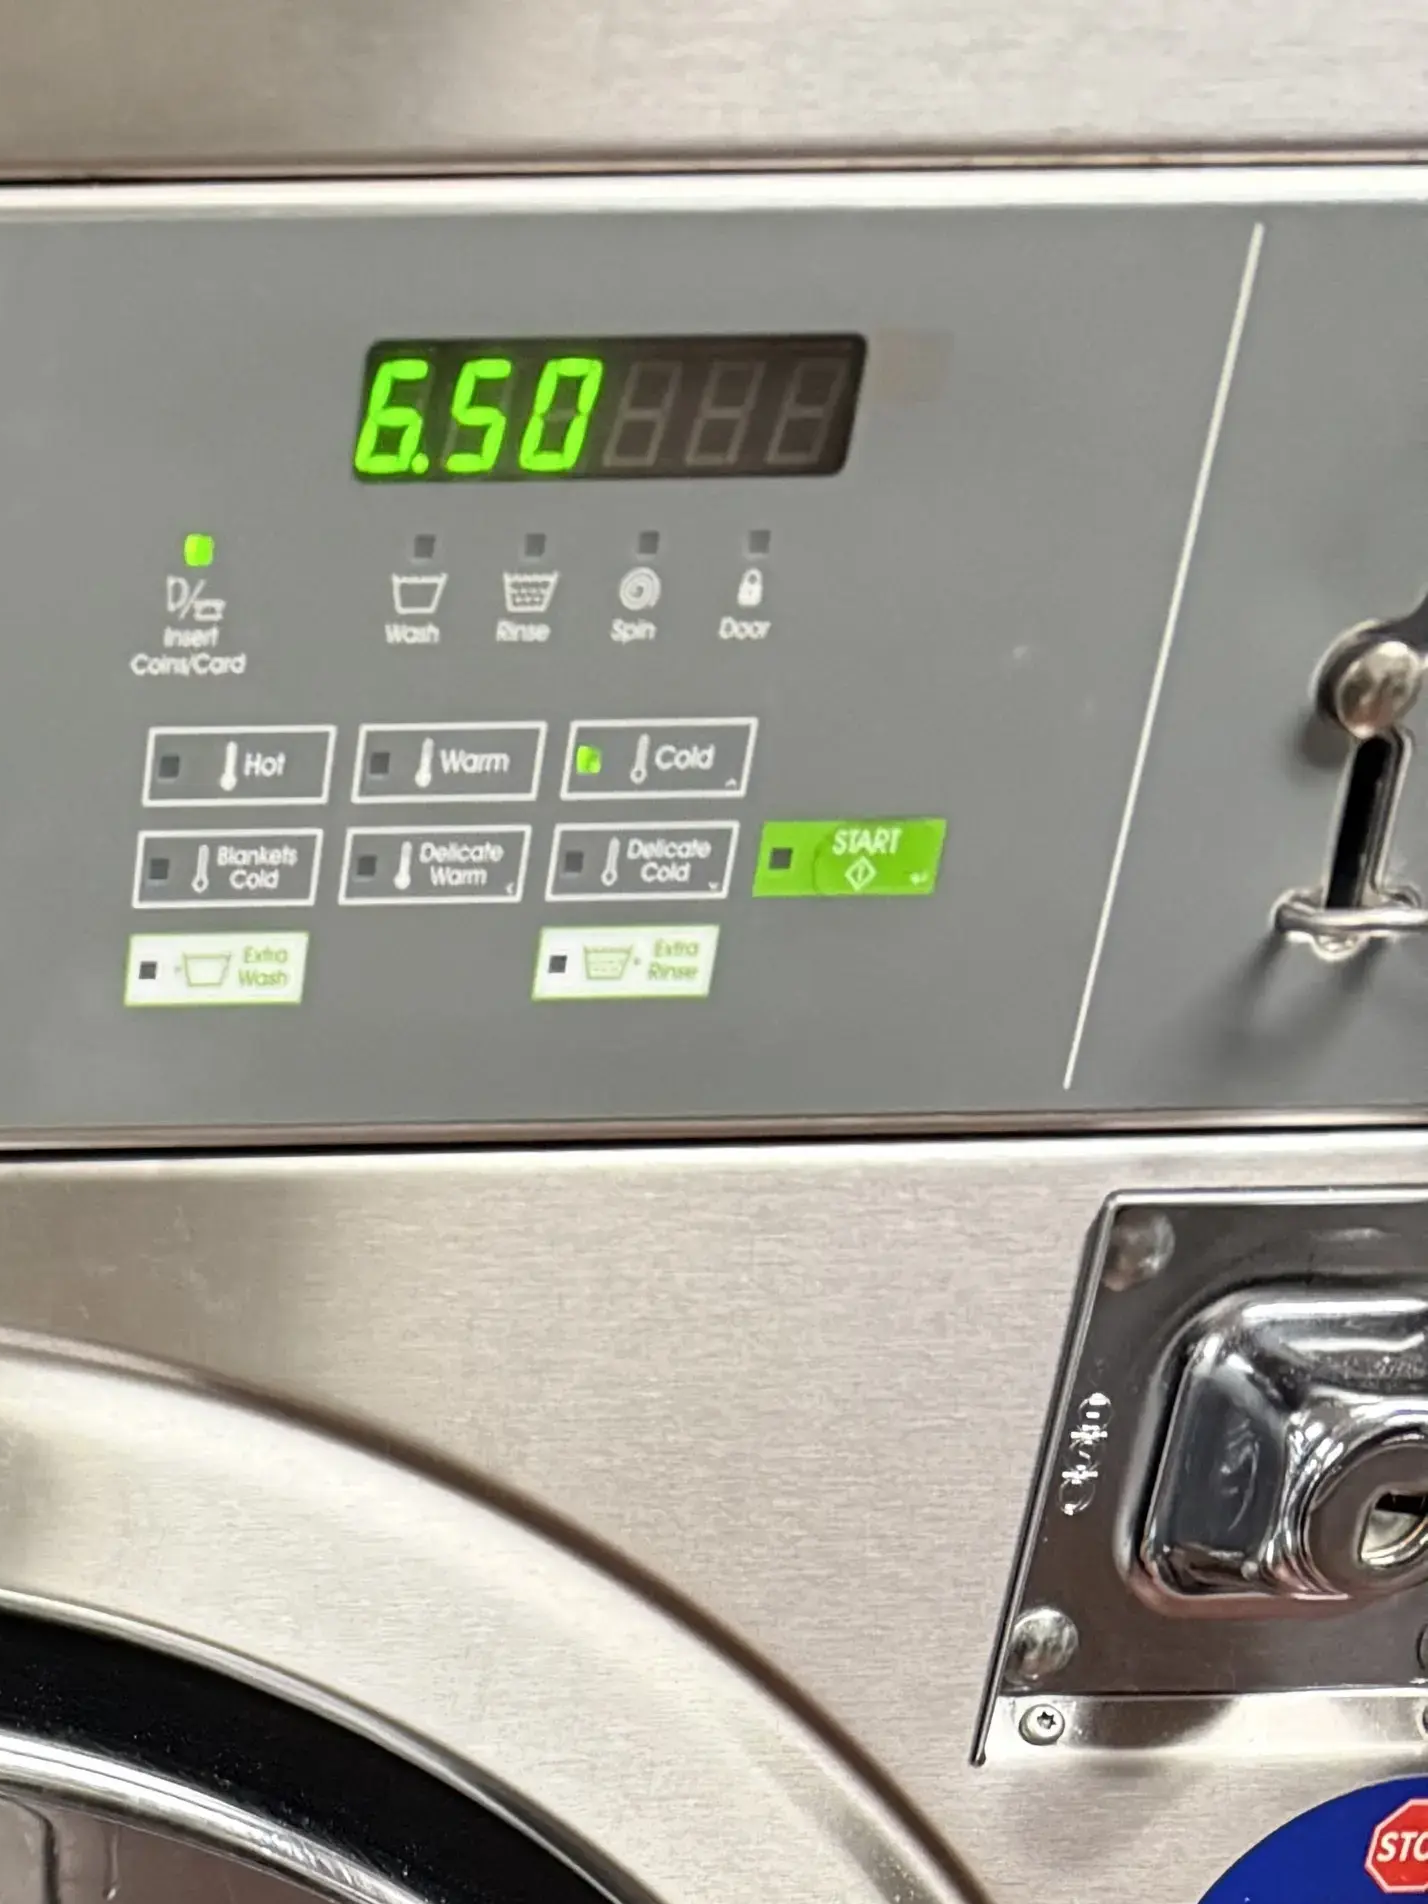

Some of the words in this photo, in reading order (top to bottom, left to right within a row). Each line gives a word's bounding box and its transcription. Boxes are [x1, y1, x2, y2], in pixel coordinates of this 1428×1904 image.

[355, 358, 603, 474] 6.50
[164, 626, 219, 648] Insert
[385, 623, 439, 644] Wash
[496, 620, 550, 641] Rinse
[611, 619, 656, 644] Spin
[718, 616, 771, 640] Door
[130, 652, 246, 676] Coins/Card
[244, 753, 285, 777] Hot
[440, 749, 510, 773] Warm
[655, 744, 715, 770] Cold
[627, 838, 711, 860] Delicate
[832, 827, 902, 855] START
[217, 845, 297, 866] Blankets
[419, 842, 504, 863] Delicate
[229, 869, 279, 890] Cold
[430, 866, 487, 886] Warm
[641, 861, 691, 883] Cold
[243, 946, 289, 964] Extra
[653, 939, 699, 959] Extra
[238, 969, 288, 987] Wash
[648, 961, 699, 980] Rinse
